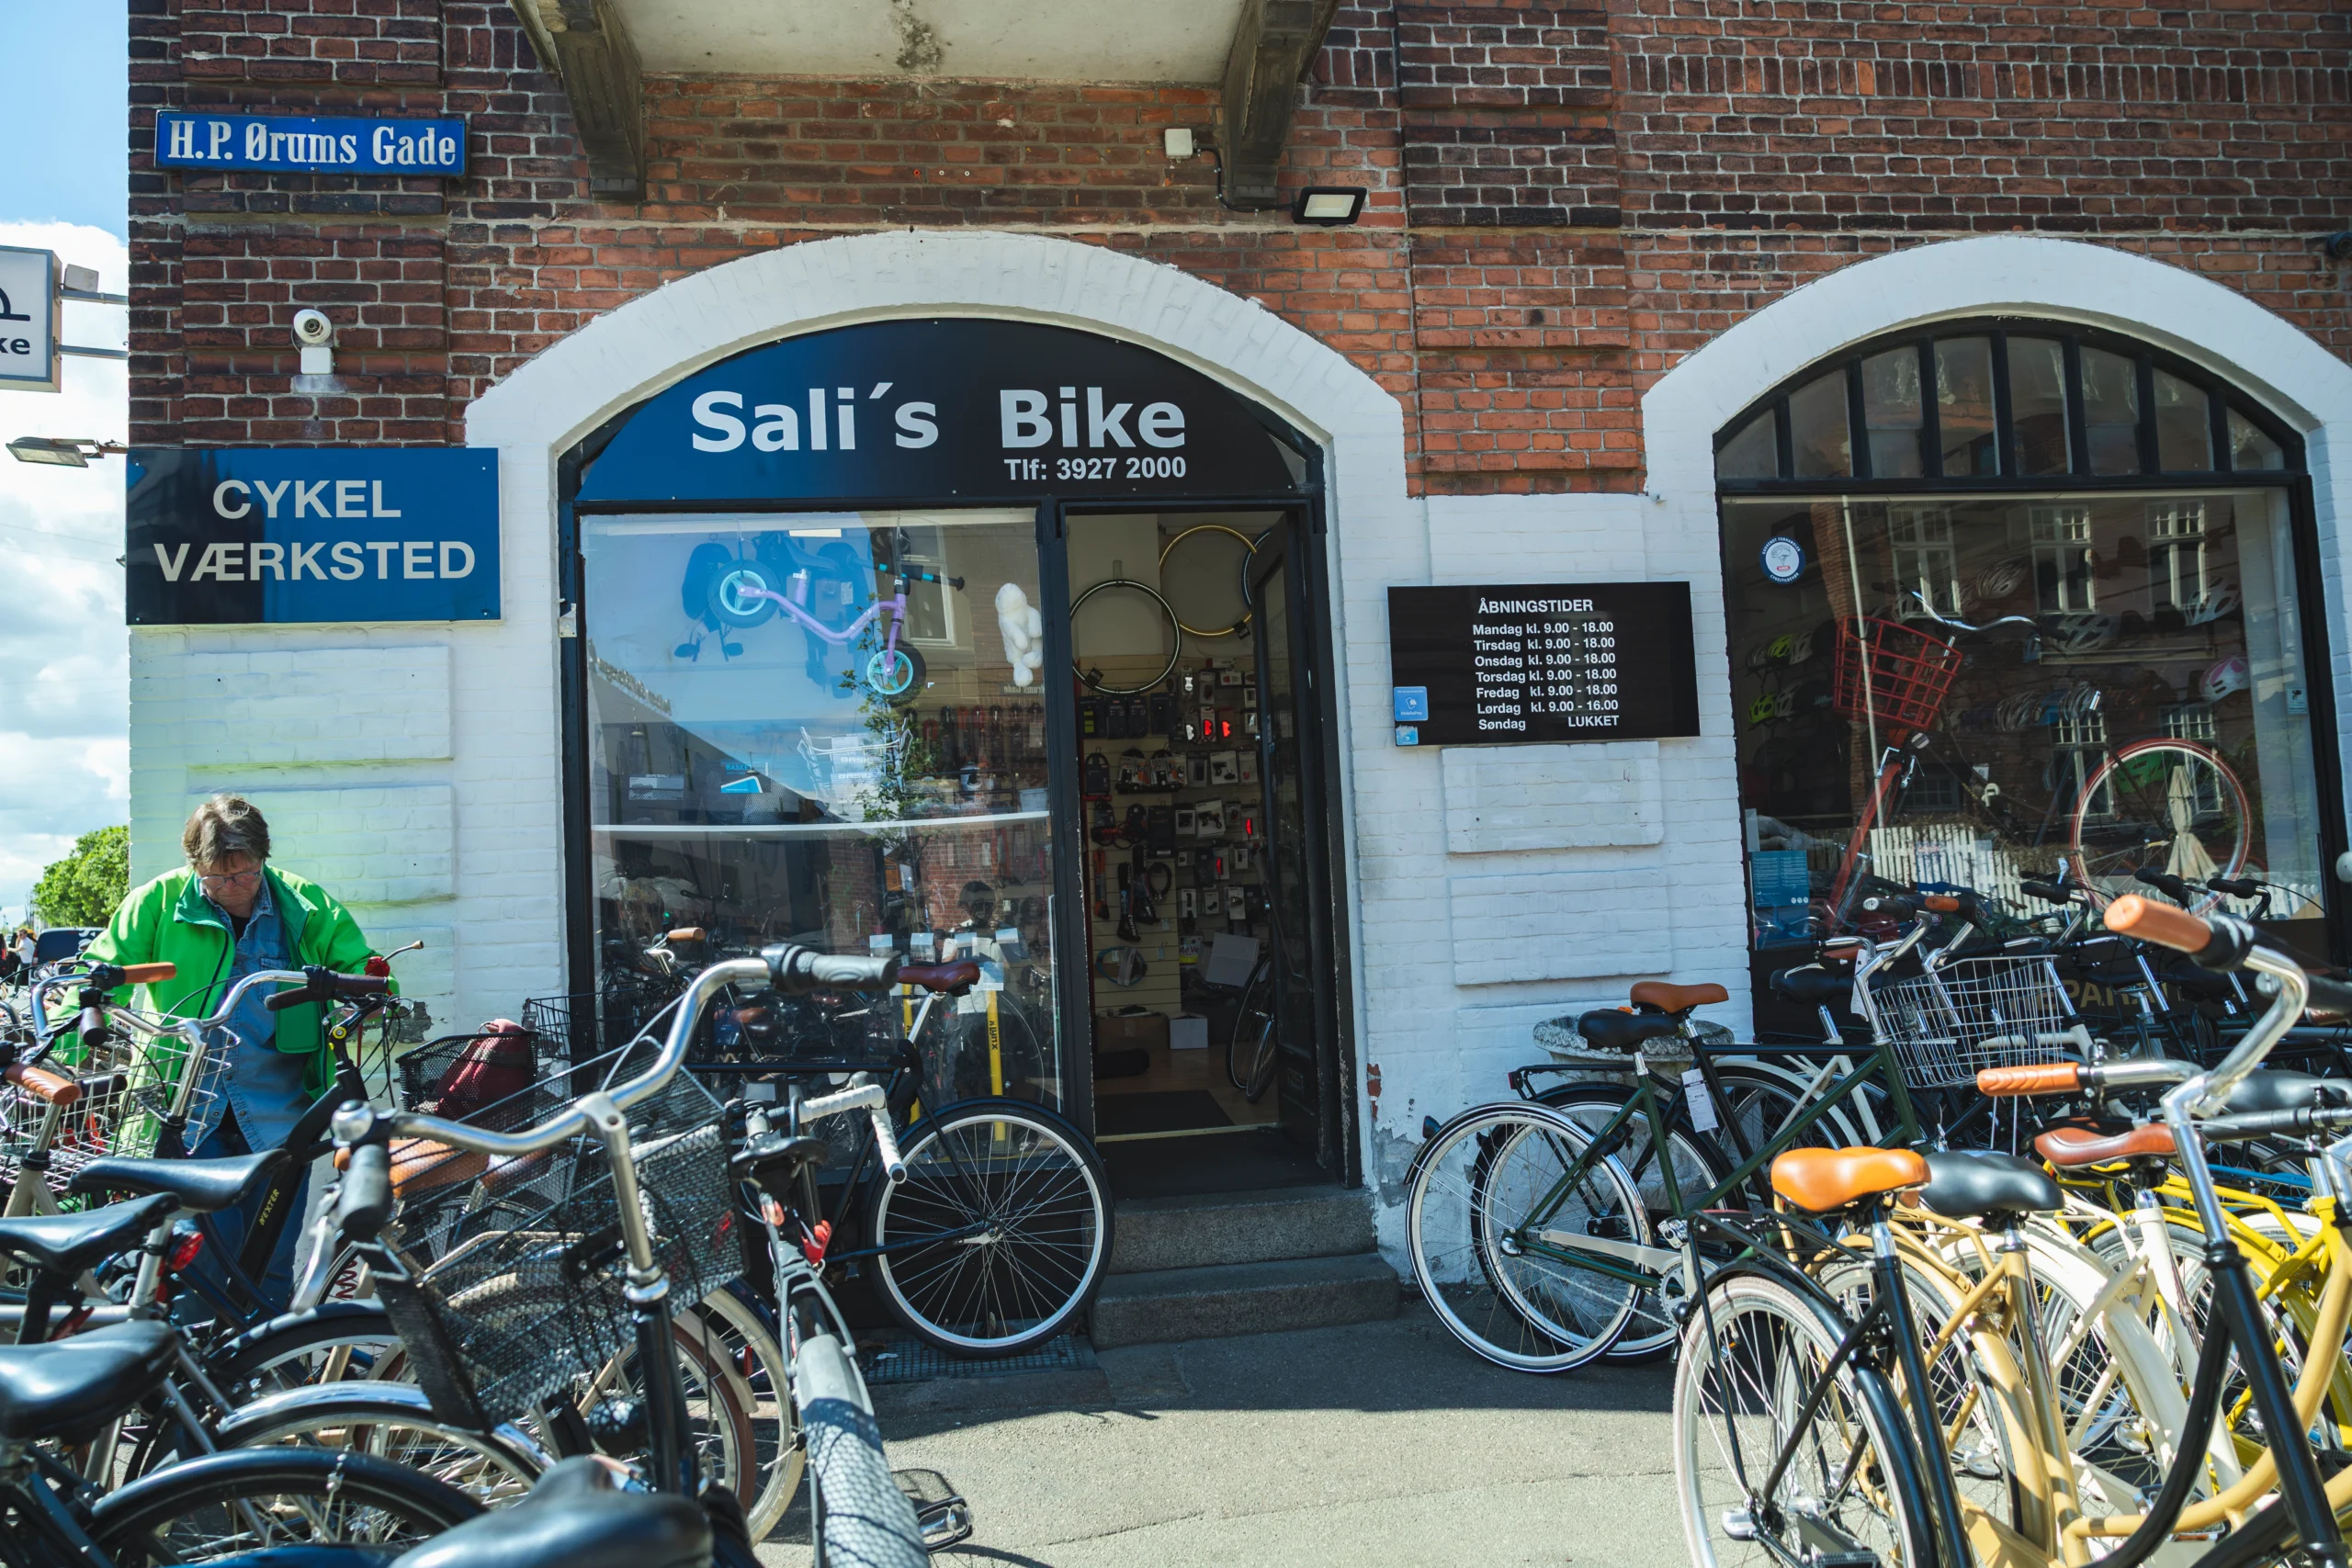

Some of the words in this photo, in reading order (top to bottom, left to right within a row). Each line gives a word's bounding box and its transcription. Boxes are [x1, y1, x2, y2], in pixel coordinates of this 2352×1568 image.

[167, 119, 233, 160] H.P.
[244, 122, 357, 164] Ørums
[371, 126, 457, 165] Gade
[999, 386, 1186, 448] Bike
[1003, 458, 1047, 481] Tlf:
[1056, 457, 1117, 480] 3927
[1125, 456, 1187, 479] 2000
[212, 479, 402, 519] CYKEL
[153, 540, 476, 582] VÆRKSTED
[1477, 597, 1594, 614] ÅBNINGSTIDER
[1472, 624, 1522, 637] Mandag
[1526, 623, 1541, 634] kl.
[1544, 622, 1569, 634] 9.00
[1582, 621, 1614, 633] 18.00
[1474, 639, 1521, 653] Tirsdag
[1528, 638, 1543, 649] kl.
[1545, 637, 1571, 649] 9.00
[1583, 637, 1615, 649] 18.00
[1475, 655, 1523, 669] Onsdag
[1528, 654, 1543, 666] kl.
[1545, 653, 1572, 665] 9.00
[1584, 652, 1616, 664] 18.00
[1475, 671, 1526, 684] Torsdag
[1529, 670, 1544, 682] kl.
[1546, 669, 1573, 681] 9.00
[1585, 668, 1617, 680] 18.00
[1476, 686, 1520, 700] Fredag
[1530, 685, 1544, 697] kl.
[1547, 684, 1574, 696] 9.00
[1586, 683, 1618, 695] 18.00
[1476, 702, 1521, 716] Lørdag
[1531, 701, 1545, 713] kl.
[1548, 700, 1575, 712] 9.00
[1587, 699, 1619, 711] 16.00
[1478, 718, 1526, 731] Søndag
[1567, 715, 1620, 728] LUKKET
[258, 1189, 280, 1226] NEXTER
